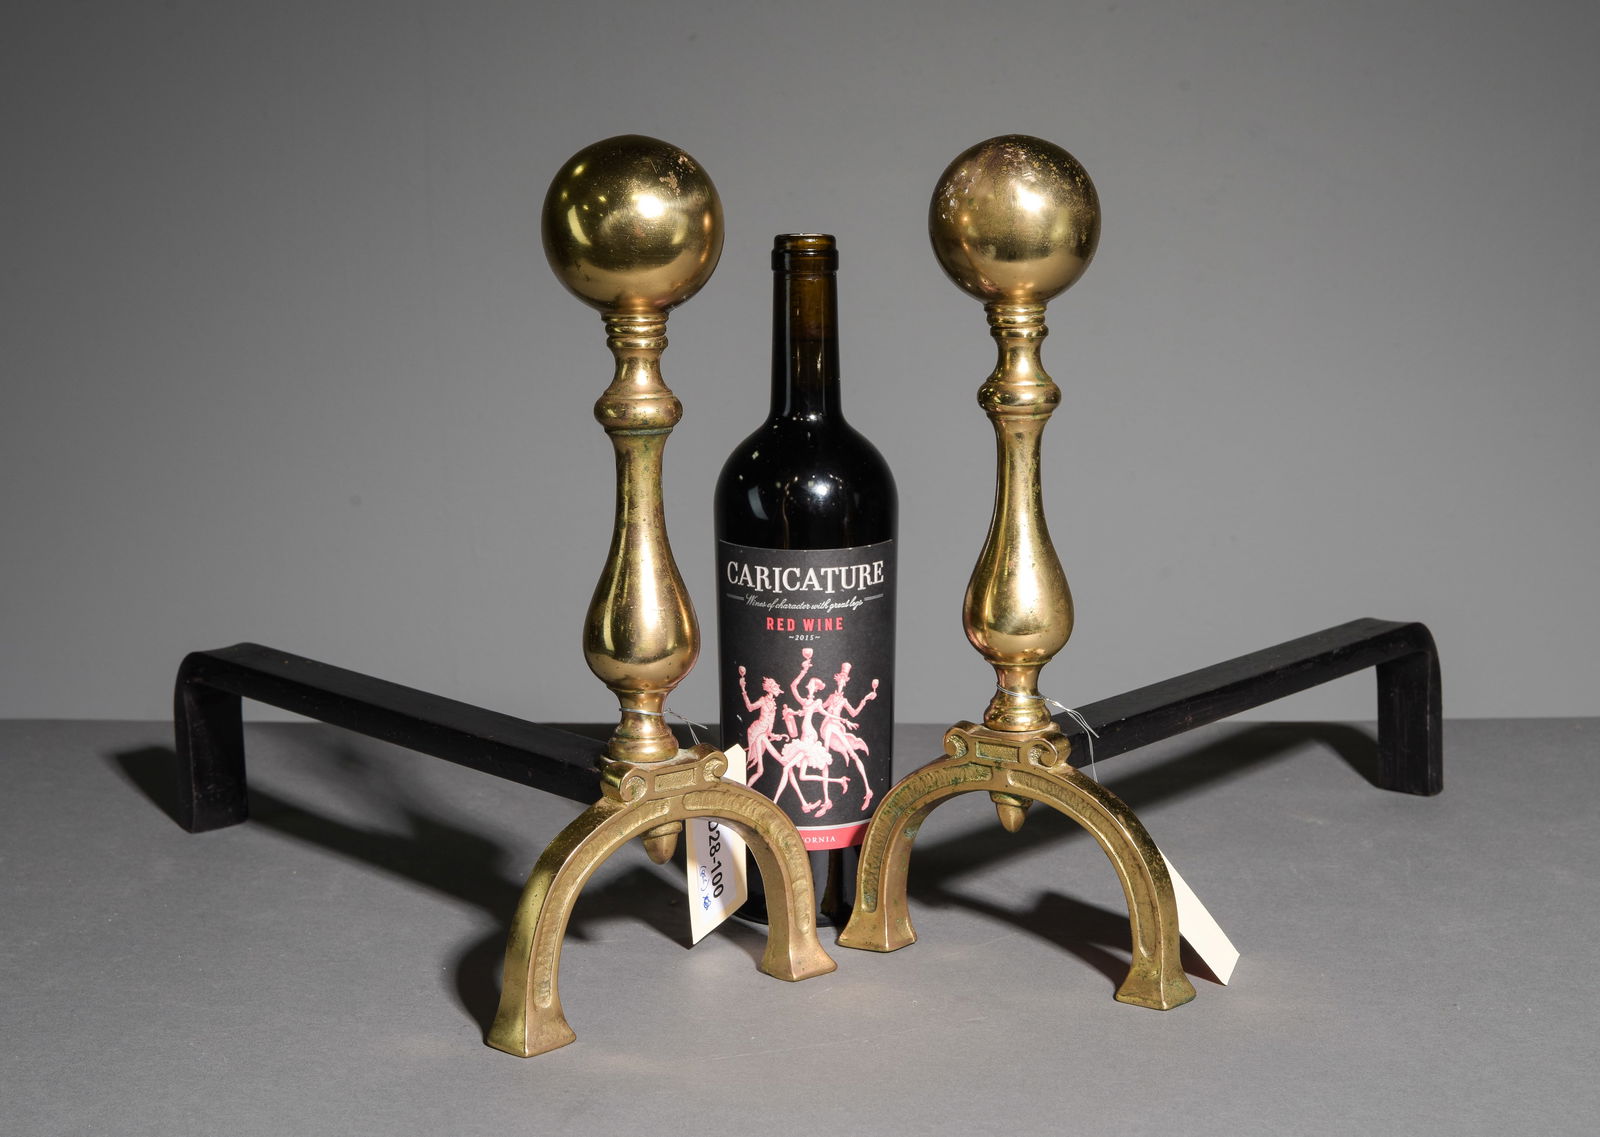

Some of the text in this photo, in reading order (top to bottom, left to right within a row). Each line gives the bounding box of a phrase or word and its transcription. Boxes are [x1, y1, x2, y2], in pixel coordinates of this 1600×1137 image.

[727, 561, 884, 593] CARICATURE
[746, 594, 863, 613] Wines of character with great legs
[766, 617, 844, 631] RED WINE
[801, 836, 836, 844] ORNIA
